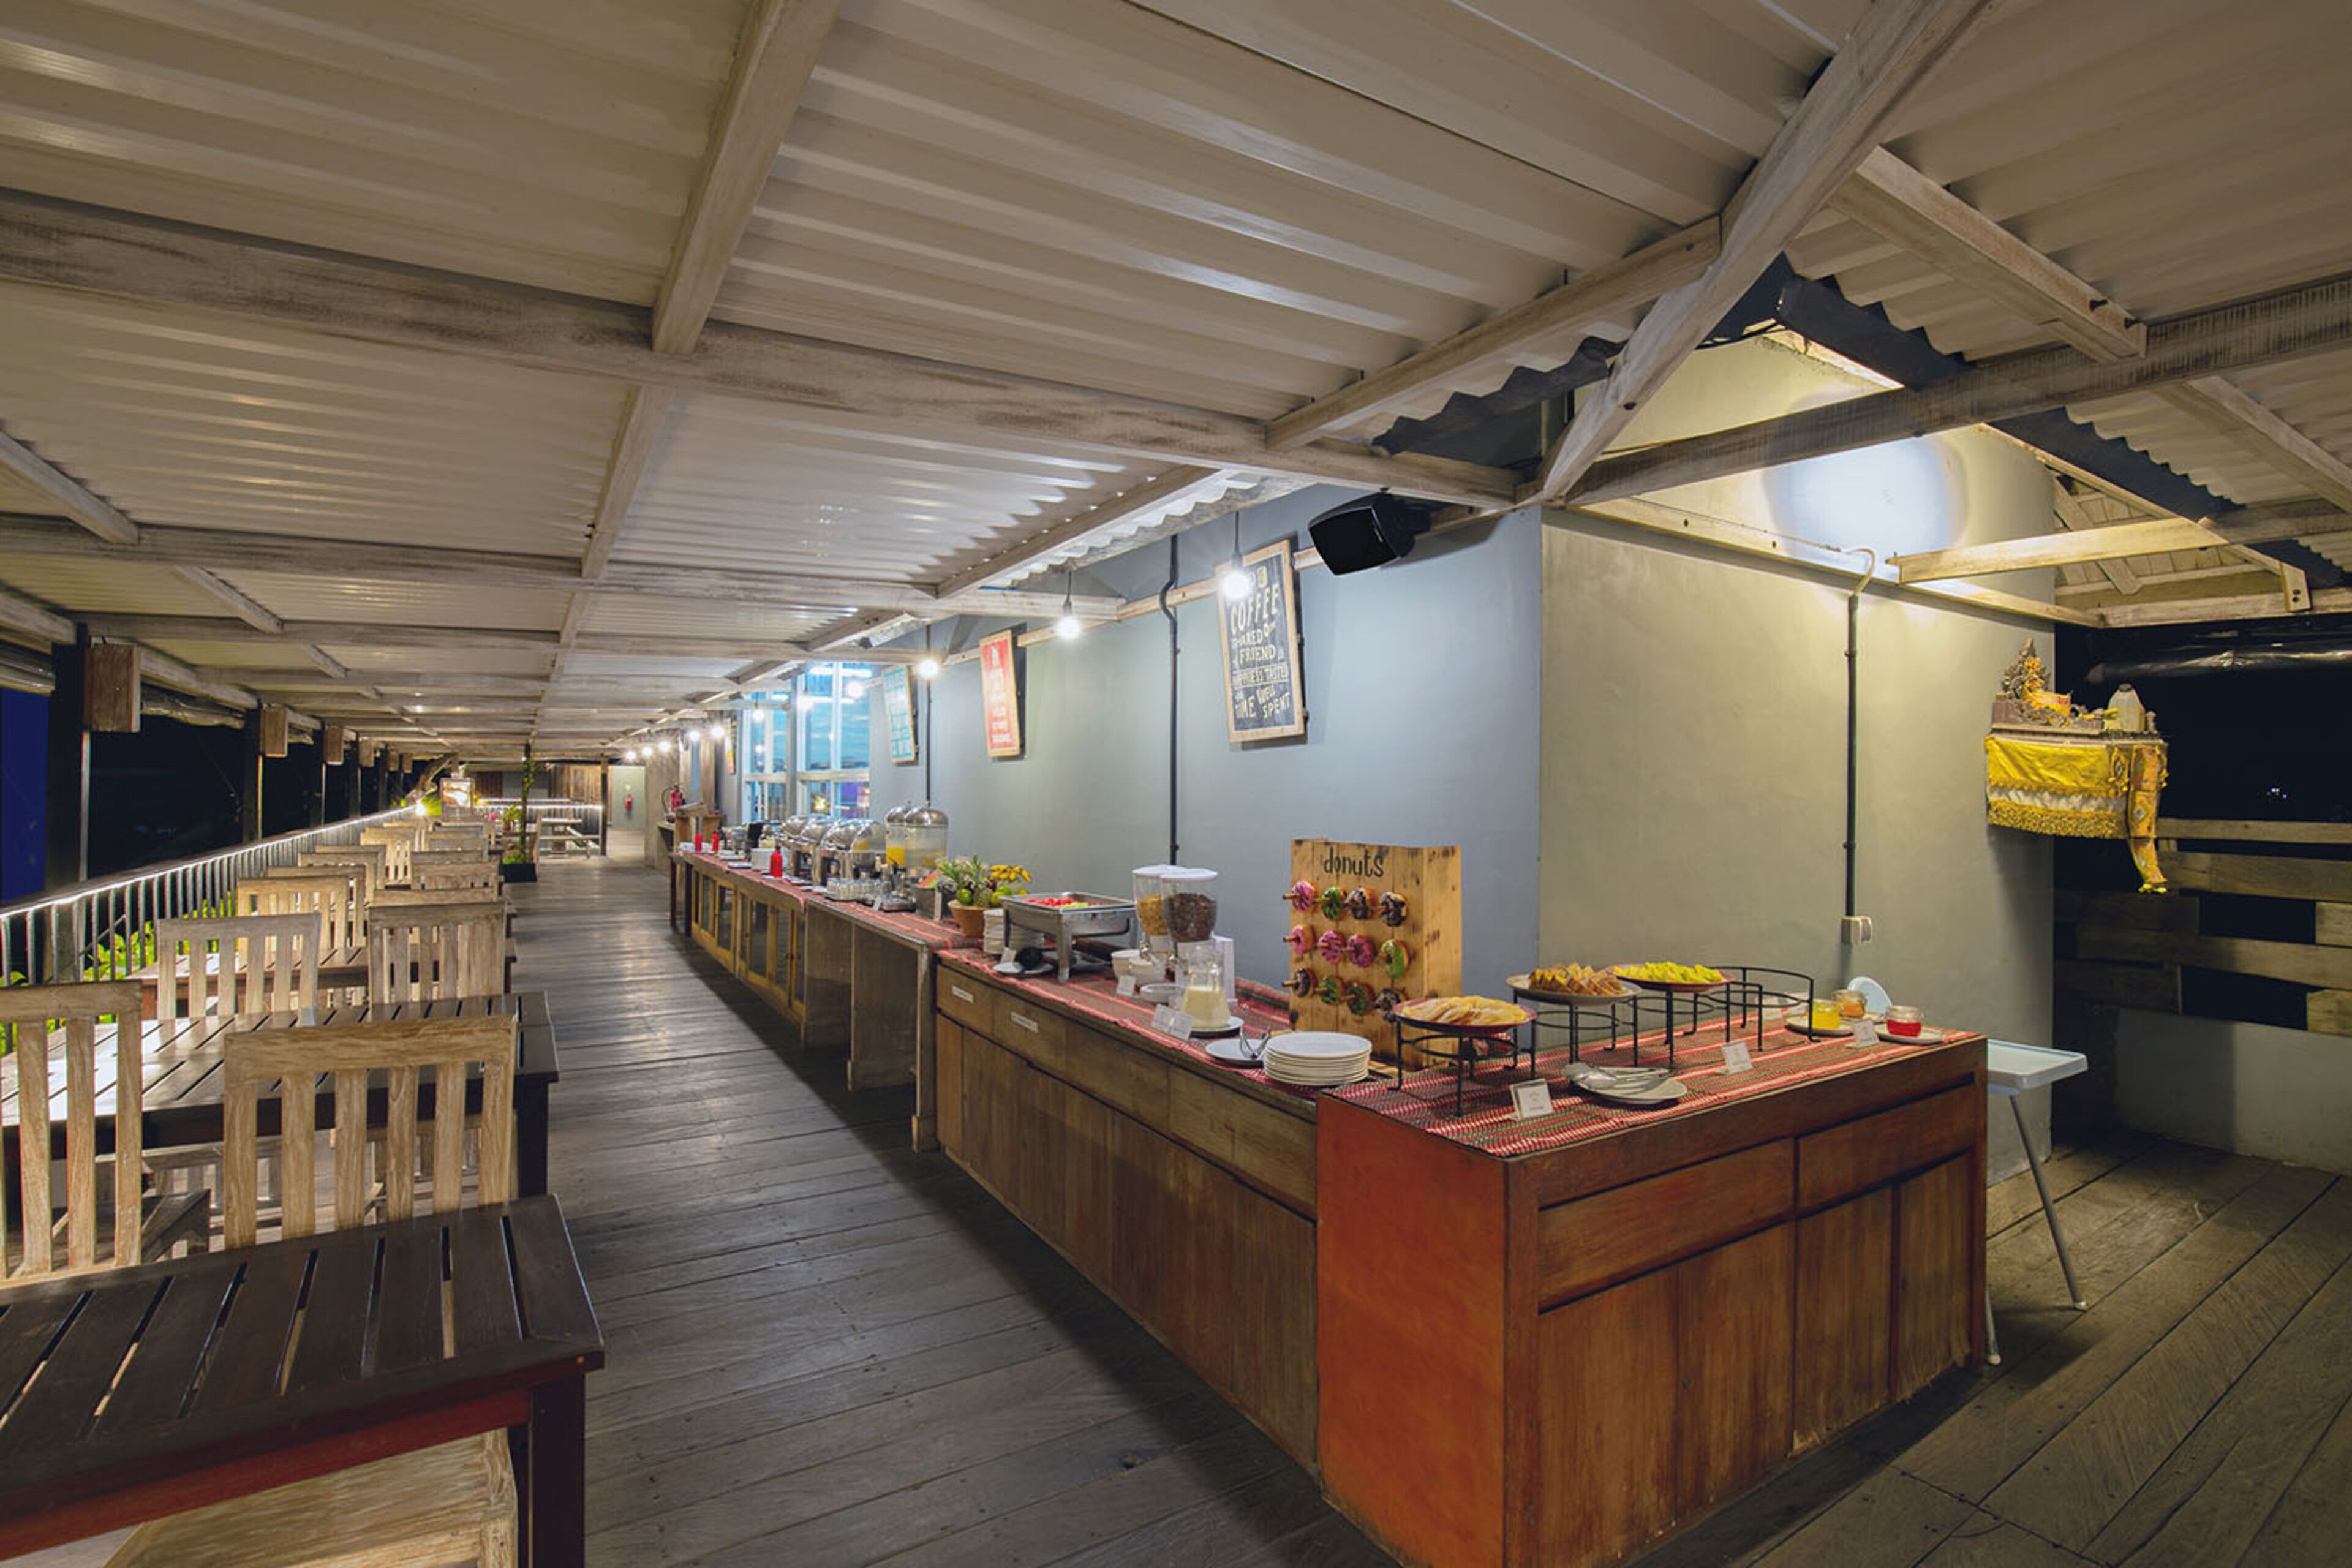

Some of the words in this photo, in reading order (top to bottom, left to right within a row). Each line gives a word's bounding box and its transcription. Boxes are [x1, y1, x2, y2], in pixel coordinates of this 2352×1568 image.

[1231, 582, 1279, 635] COFFEE
[1240, 644, 1275, 665] FRIEND
[1263, 692, 1289, 719] SPENT
[1324, 847, 1385, 877] donuts
